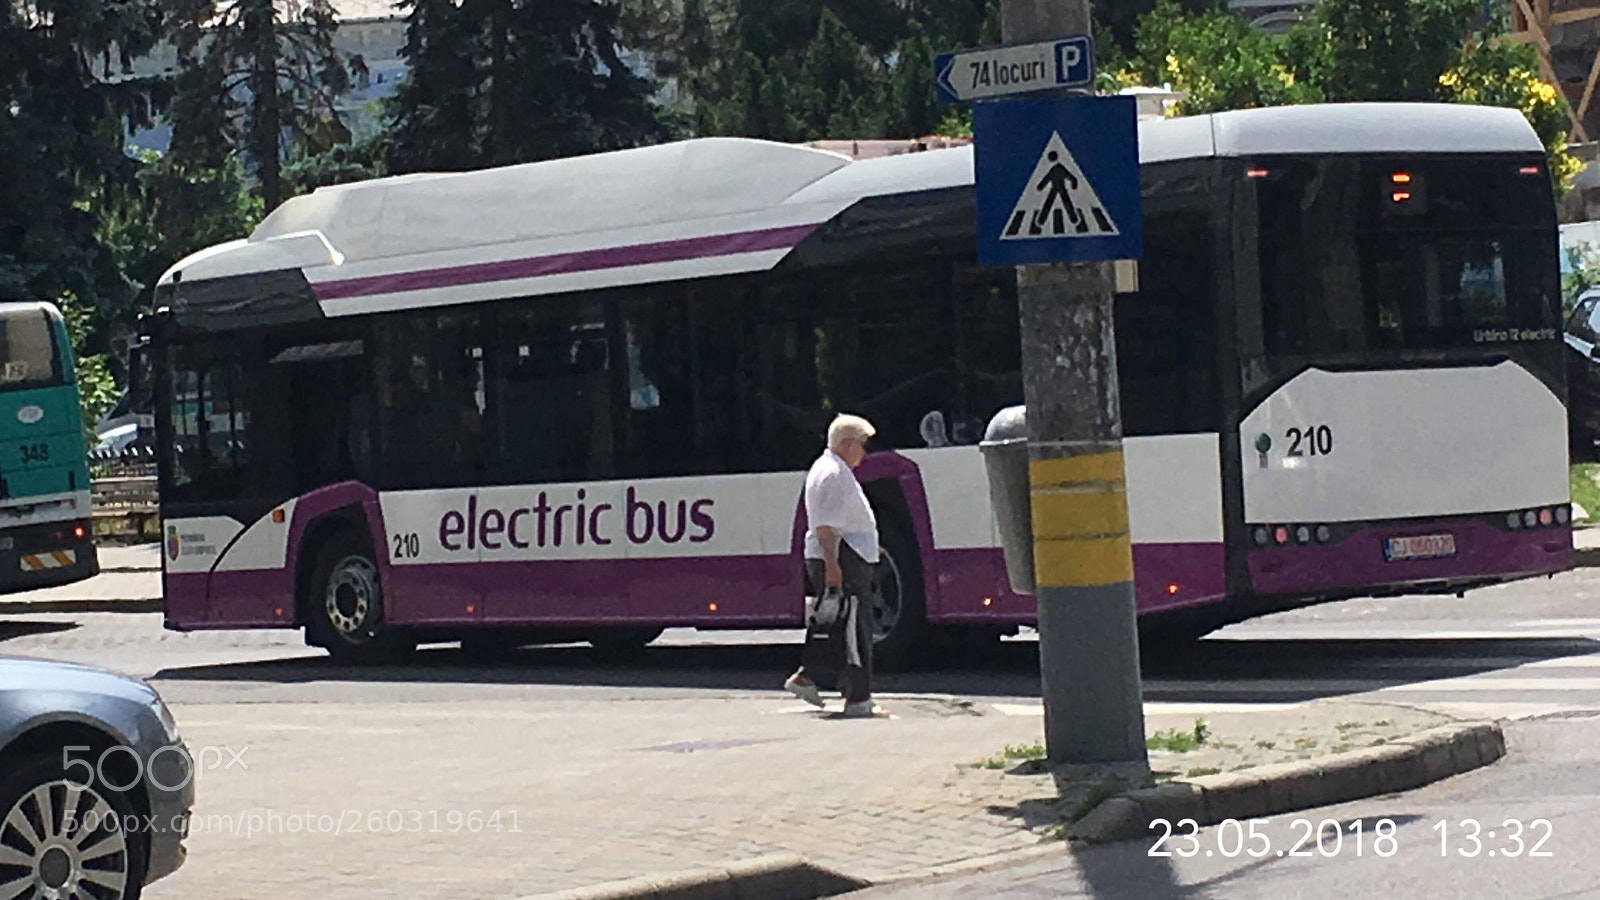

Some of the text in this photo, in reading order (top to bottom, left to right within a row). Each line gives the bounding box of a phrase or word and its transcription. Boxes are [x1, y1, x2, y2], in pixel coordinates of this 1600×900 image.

[1061, 45, 1081, 80] P
[1285, 424, 1333, 457] 210
[438, 486, 715, 551] electric bus
[393, 532, 420, 558] 210
